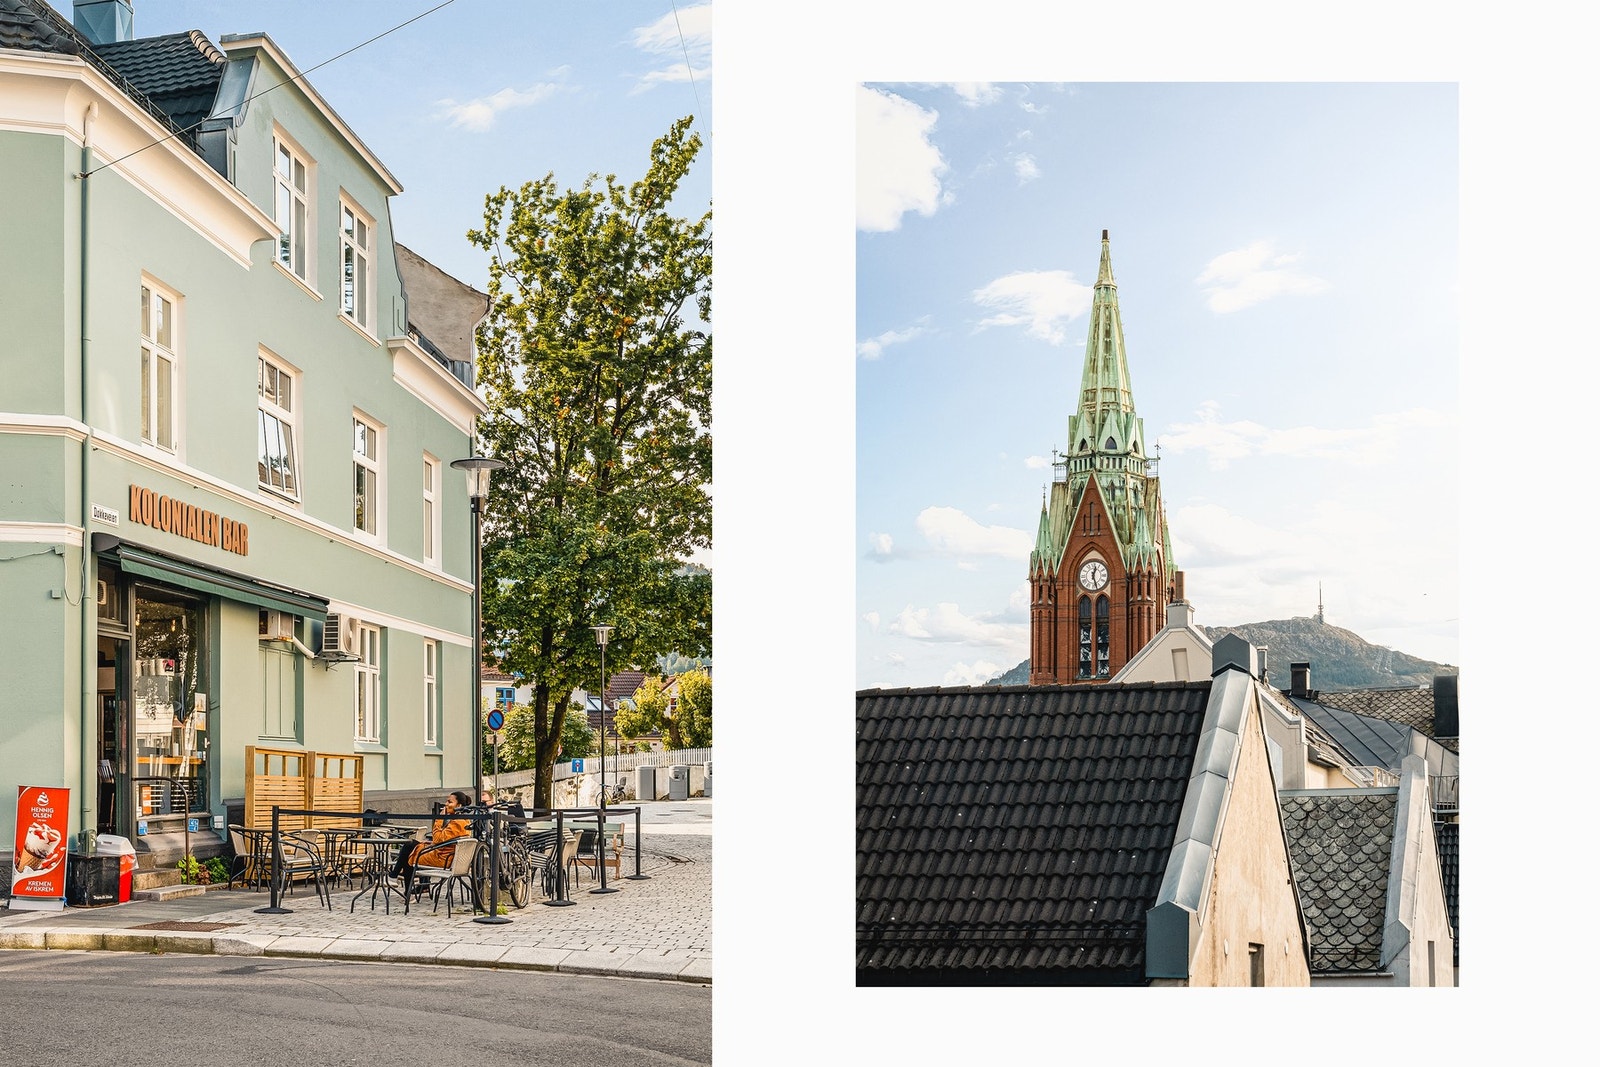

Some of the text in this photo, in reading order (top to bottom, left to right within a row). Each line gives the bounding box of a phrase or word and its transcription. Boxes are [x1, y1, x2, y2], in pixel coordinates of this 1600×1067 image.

[93, 506, 117, 523] Dokkeveien
[129, 484, 249, 556] KOLONIALEN BAR
